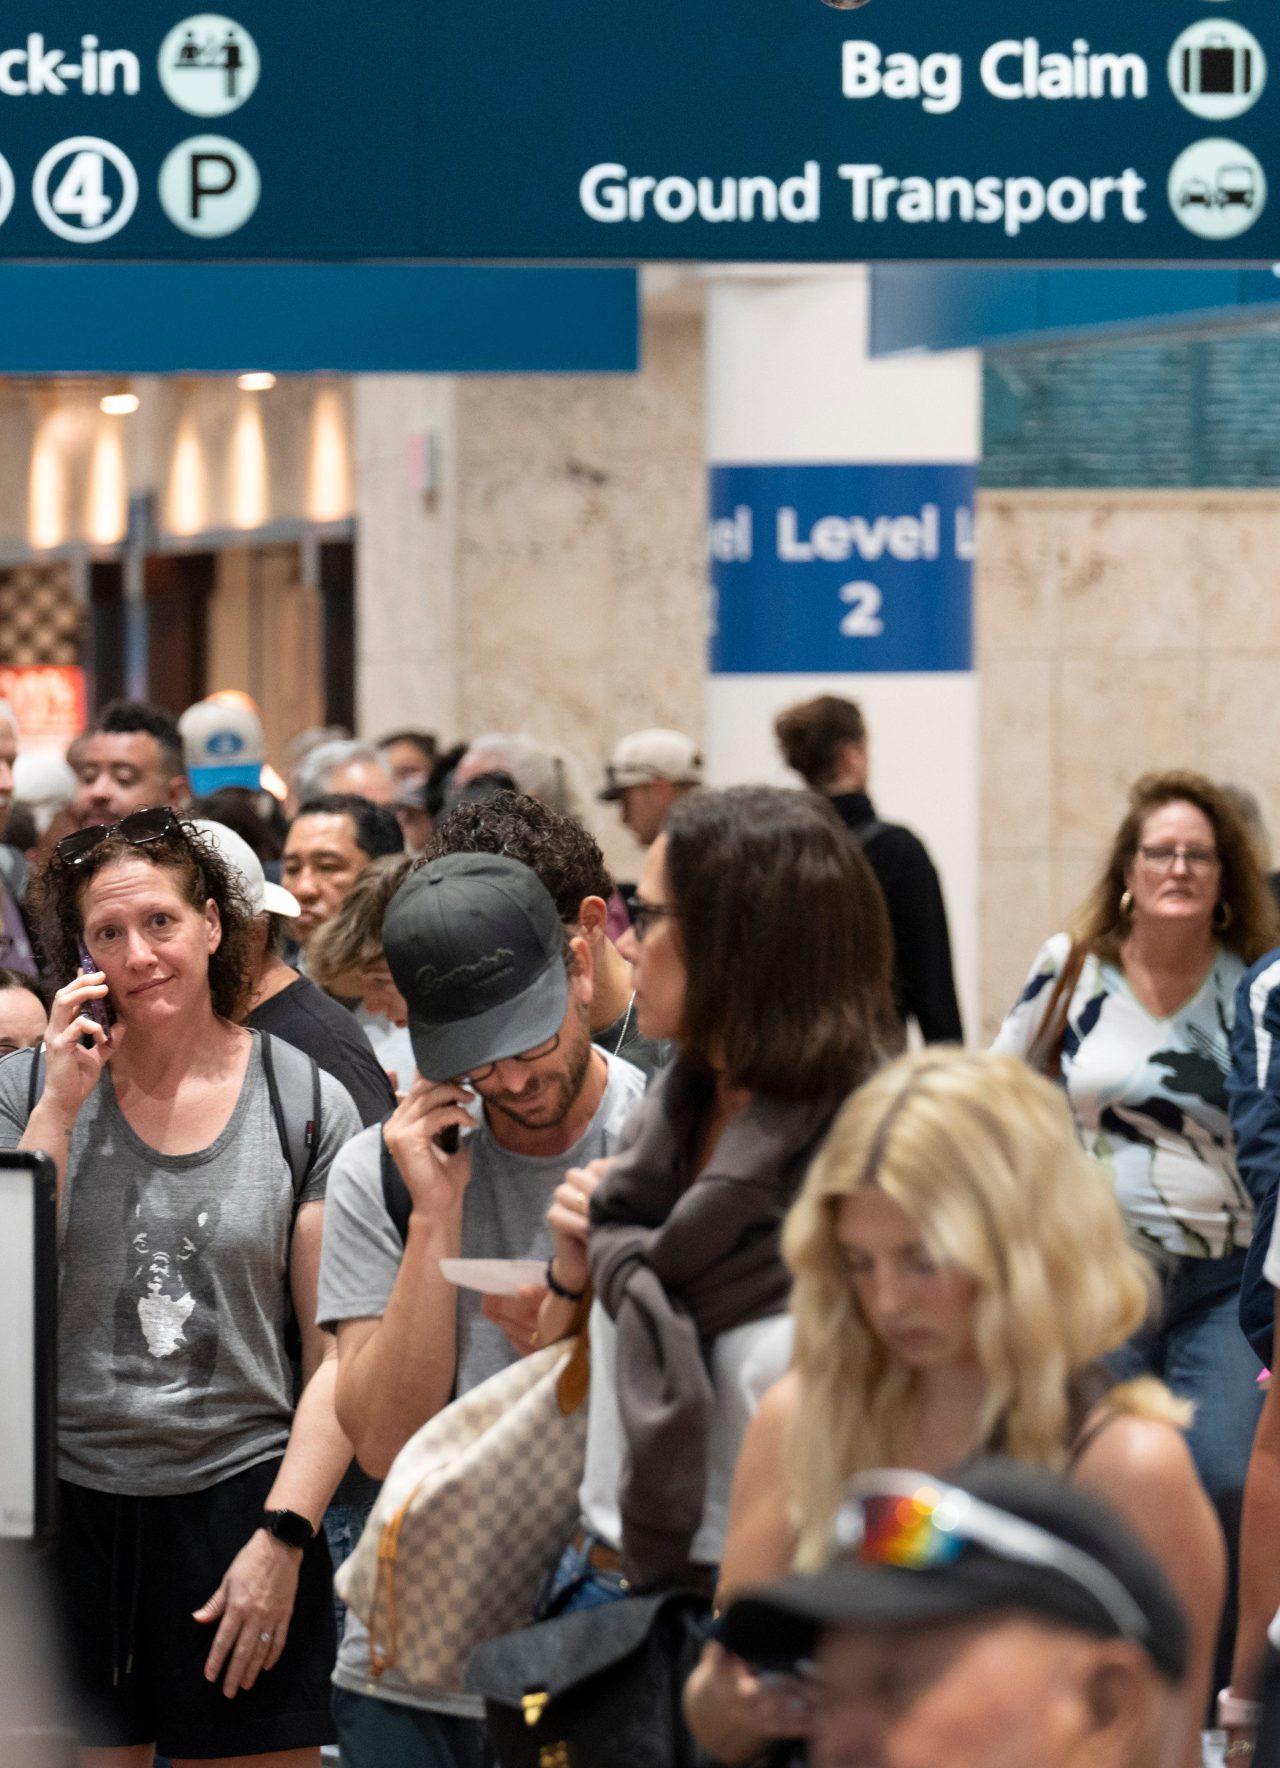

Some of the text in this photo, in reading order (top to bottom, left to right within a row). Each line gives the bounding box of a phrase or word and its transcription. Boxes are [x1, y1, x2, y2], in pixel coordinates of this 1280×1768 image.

[841, 37, 1148, 114] Bag Claim
[579, 160, 1147, 236] Ground Transport
[776, 502, 940, 562] Level
[838, 580, 884, 637] 2
